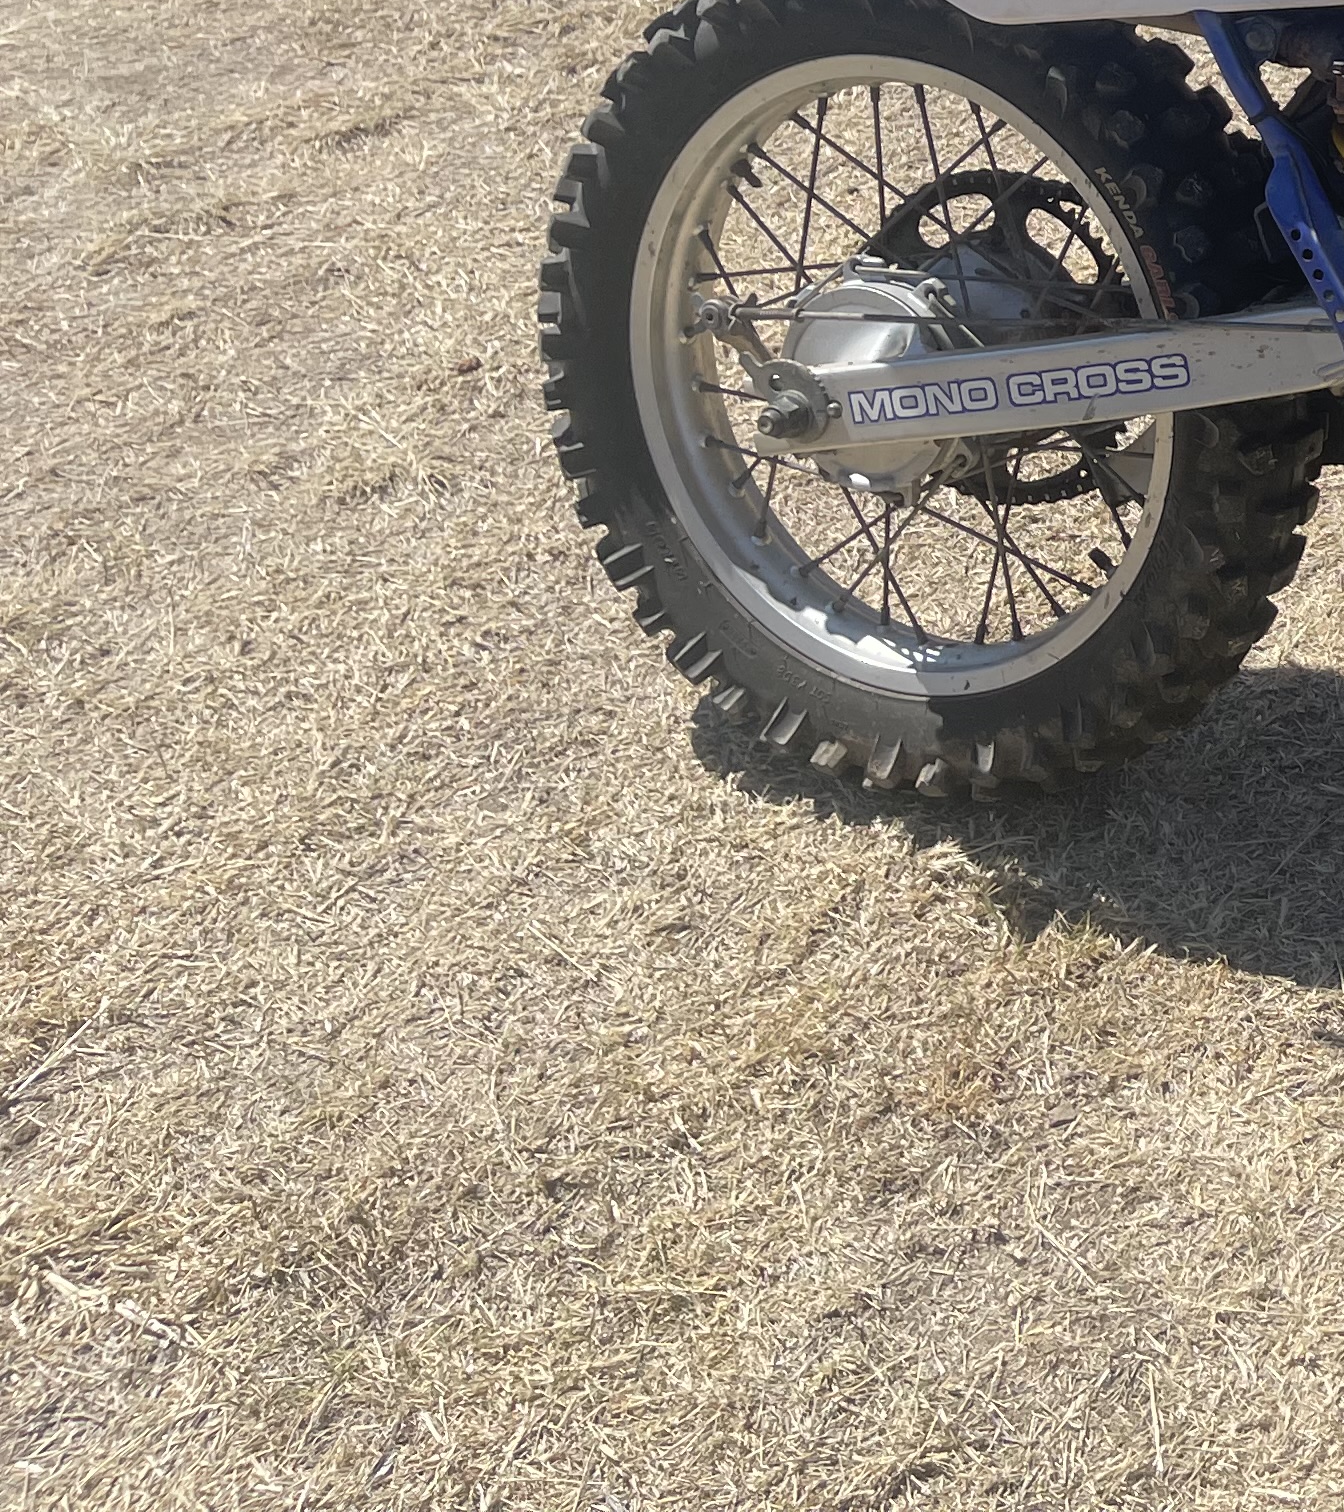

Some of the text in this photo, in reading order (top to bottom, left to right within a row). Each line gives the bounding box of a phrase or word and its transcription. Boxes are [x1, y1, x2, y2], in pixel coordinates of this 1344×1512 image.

[1094, 166, 1145, 239] KENDA
[848, 353, 1191, 425] MONO CROSS
